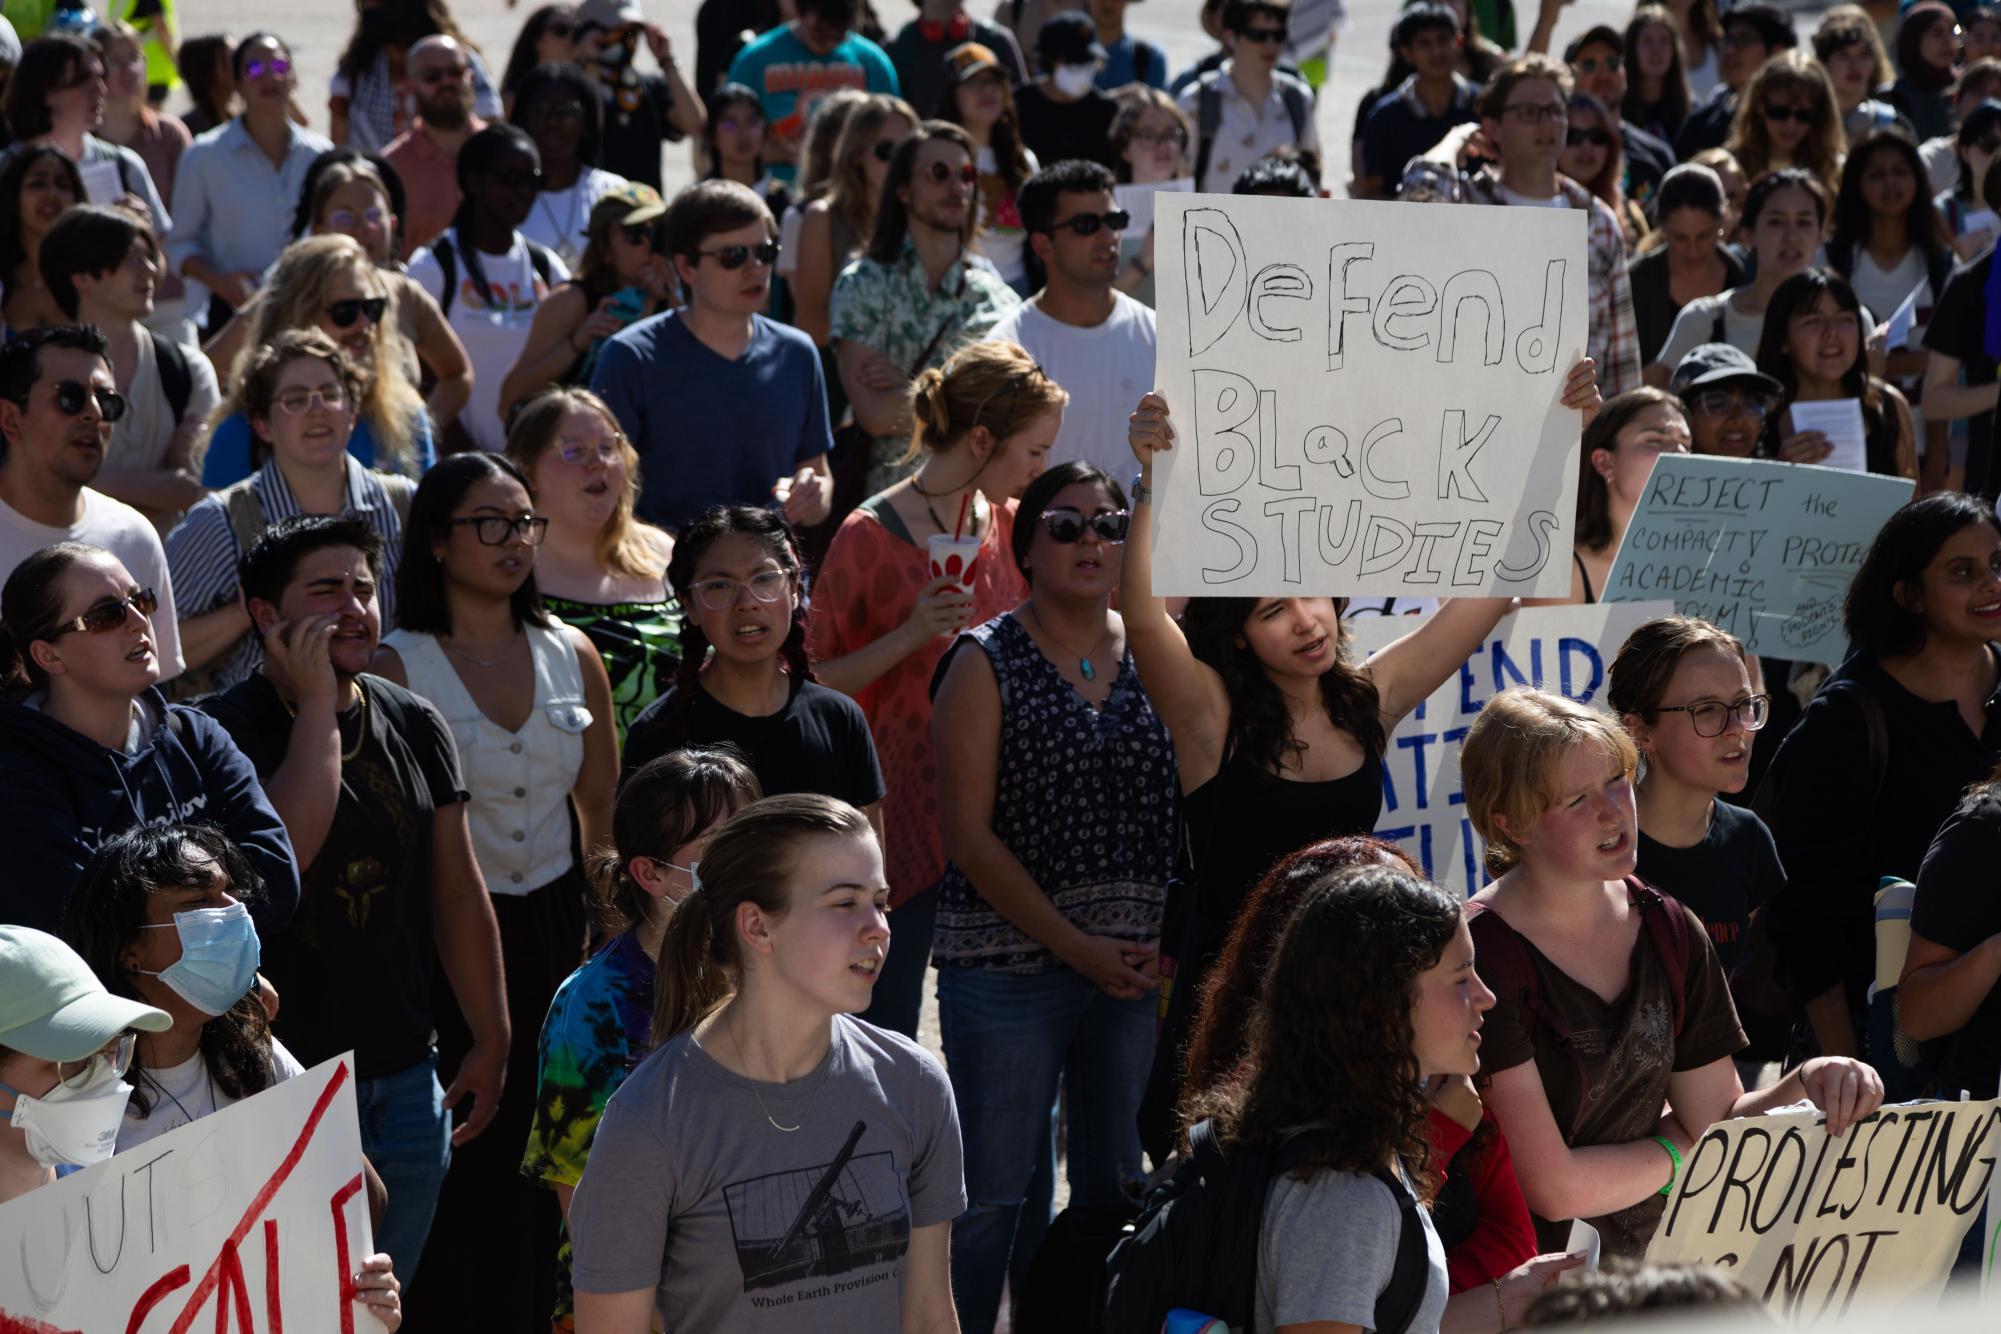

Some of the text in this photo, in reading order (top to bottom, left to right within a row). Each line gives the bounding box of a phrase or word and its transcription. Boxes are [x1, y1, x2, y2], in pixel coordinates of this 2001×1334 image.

[1648, 472, 1838, 518] REJECT the
[1201, 496, 1560, 587] STUDIES
[1619, 561, 1766, 602] ACADEMIC
[1664, 1106, 2001, 1237] PROTESTING
[751, 1293, 794, 1308] Whole
[797, 1285, 831, 1302] Earth
[833, 1271, 890, 1294] Provision
[1761, 1230, 1900, 1326] NOT
